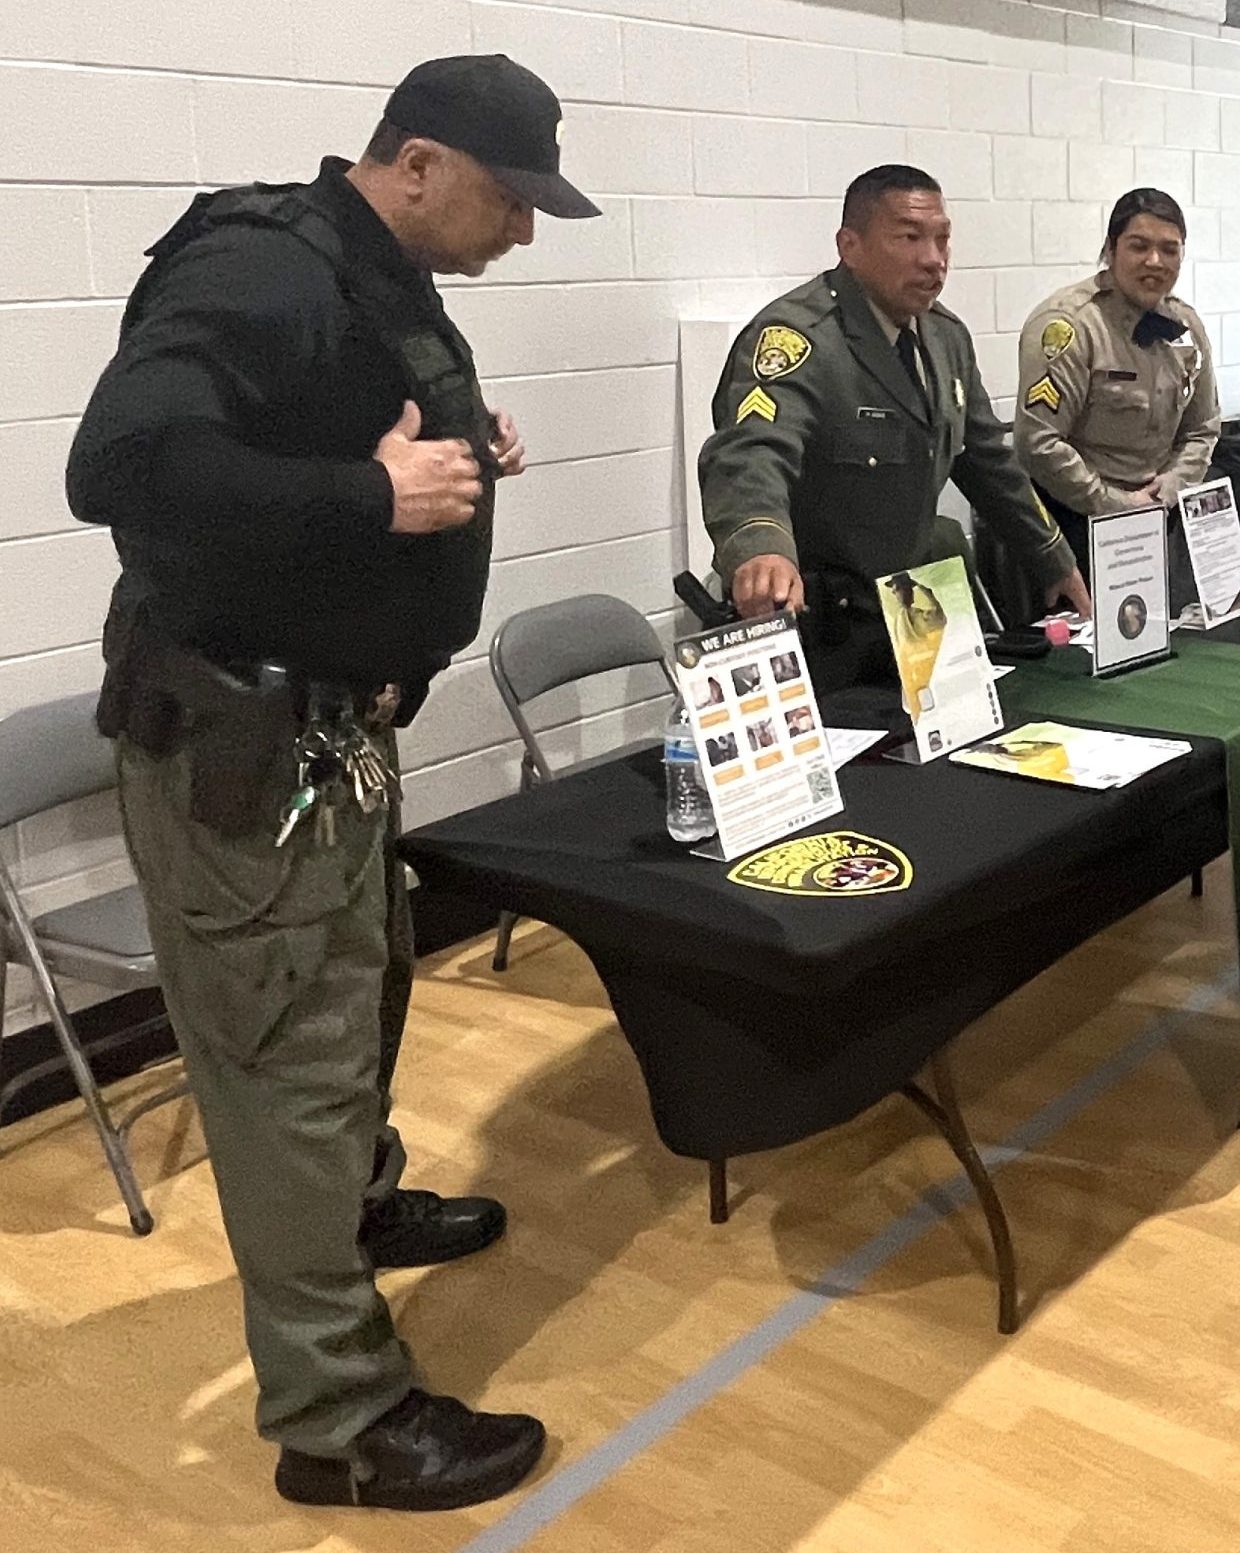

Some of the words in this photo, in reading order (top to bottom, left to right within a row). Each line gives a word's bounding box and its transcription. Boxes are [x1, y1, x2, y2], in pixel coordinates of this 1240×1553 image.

[701, 636, 720, 651] WE
[723, 629, 746, 646] ARE
[746, 618, 787, 639] HIRING!
